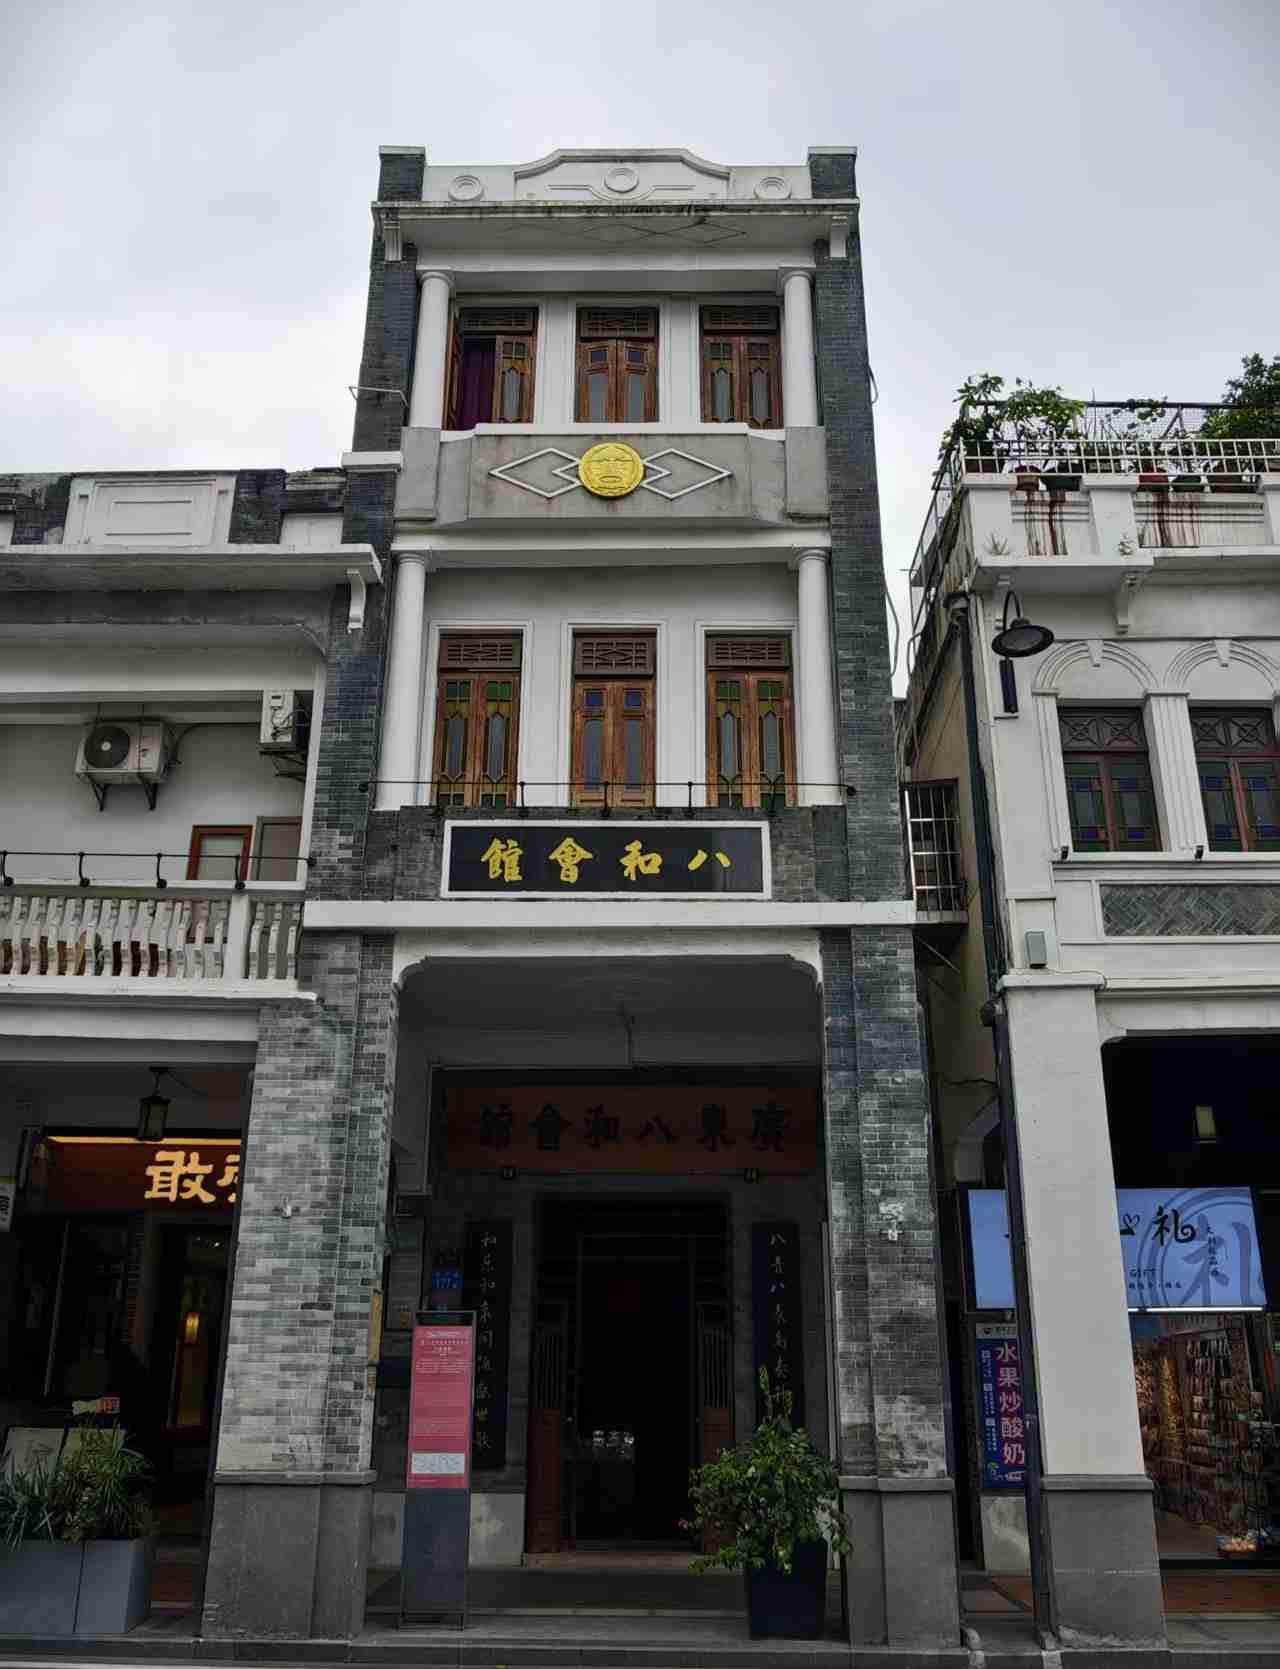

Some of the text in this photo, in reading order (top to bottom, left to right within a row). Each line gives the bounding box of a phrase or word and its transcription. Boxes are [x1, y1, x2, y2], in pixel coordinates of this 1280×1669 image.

[994, 1341, 1025, 1466] 水果炒酸奶
